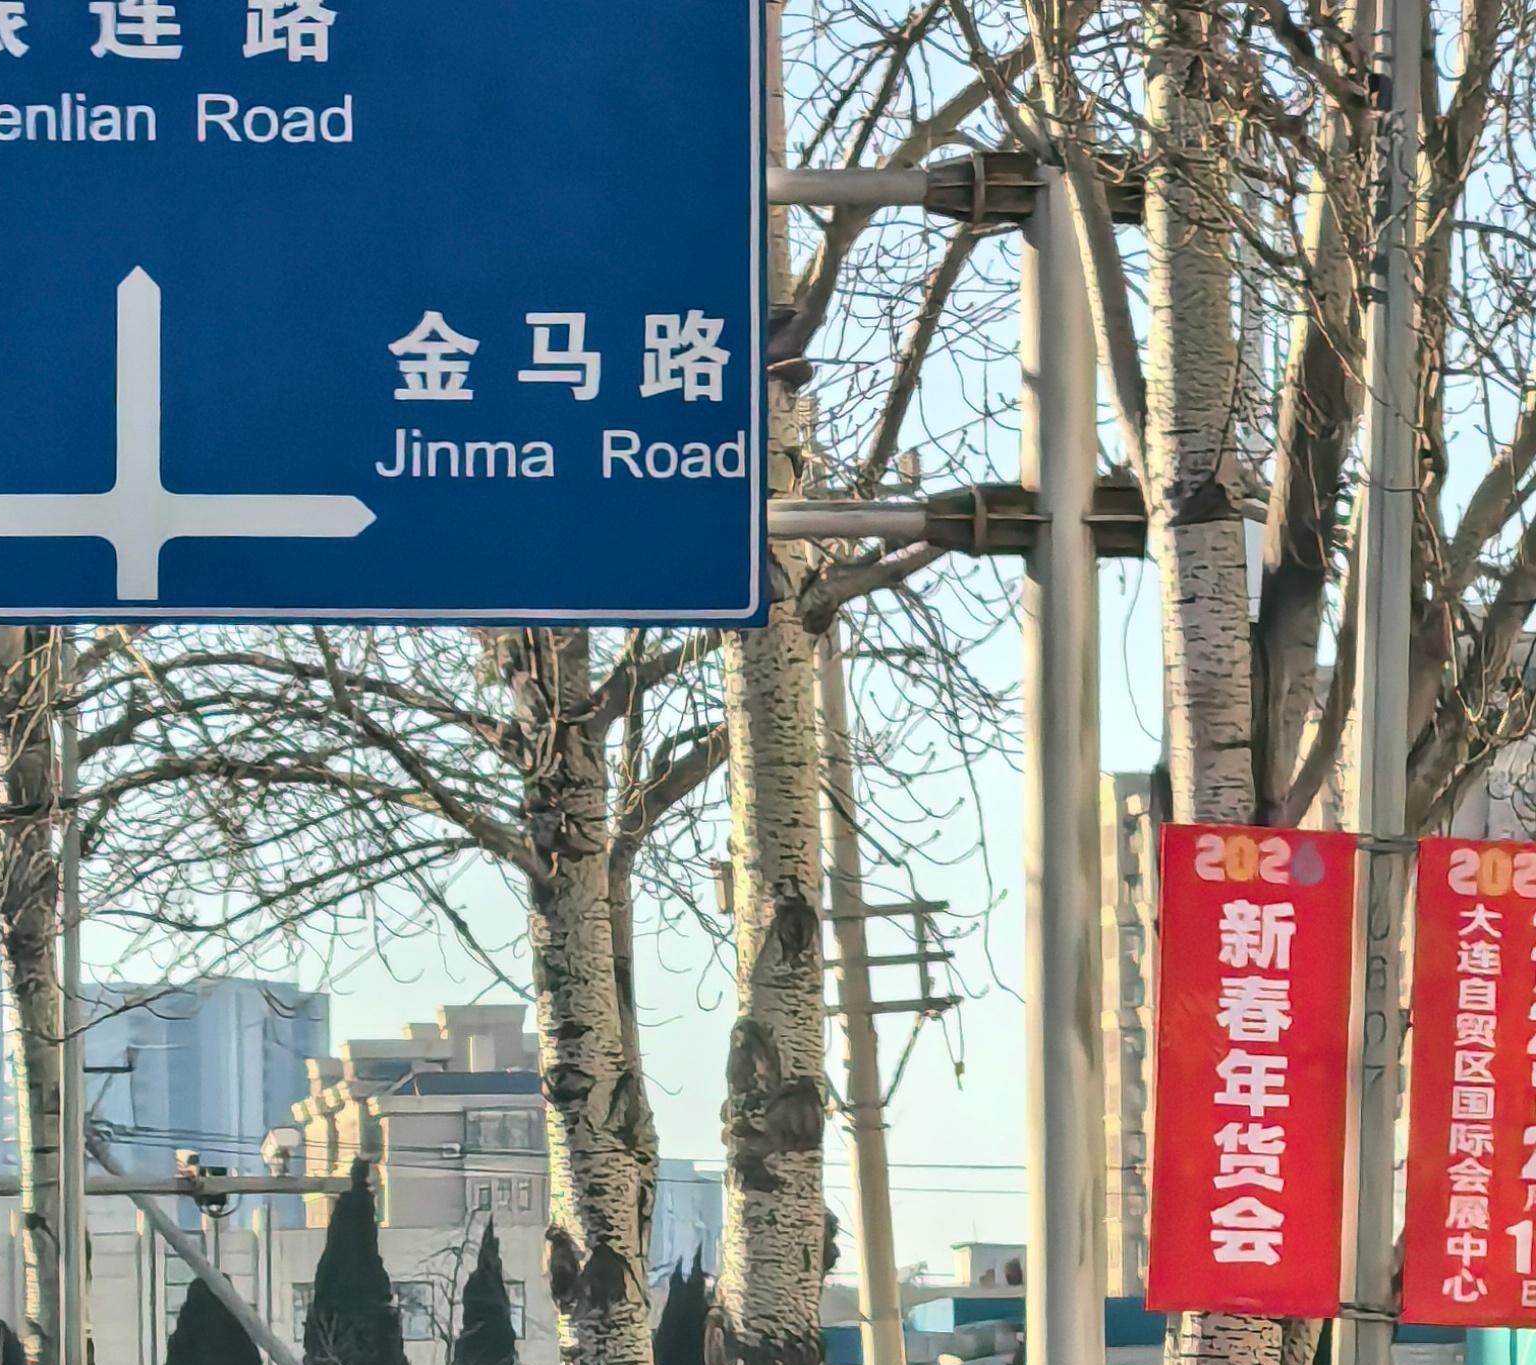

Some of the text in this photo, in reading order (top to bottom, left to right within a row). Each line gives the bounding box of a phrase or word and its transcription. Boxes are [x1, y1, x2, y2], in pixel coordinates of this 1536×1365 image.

[197, 94, 353, 142] Road
[388, 310, 731, 402] 金马路
[375, 429, 746, 478] Jinma Road
[1209, 899, 1297, 1265] 新春年货会
[1442, 903, 1503, 1302] 大连自贸区国际会展中心
